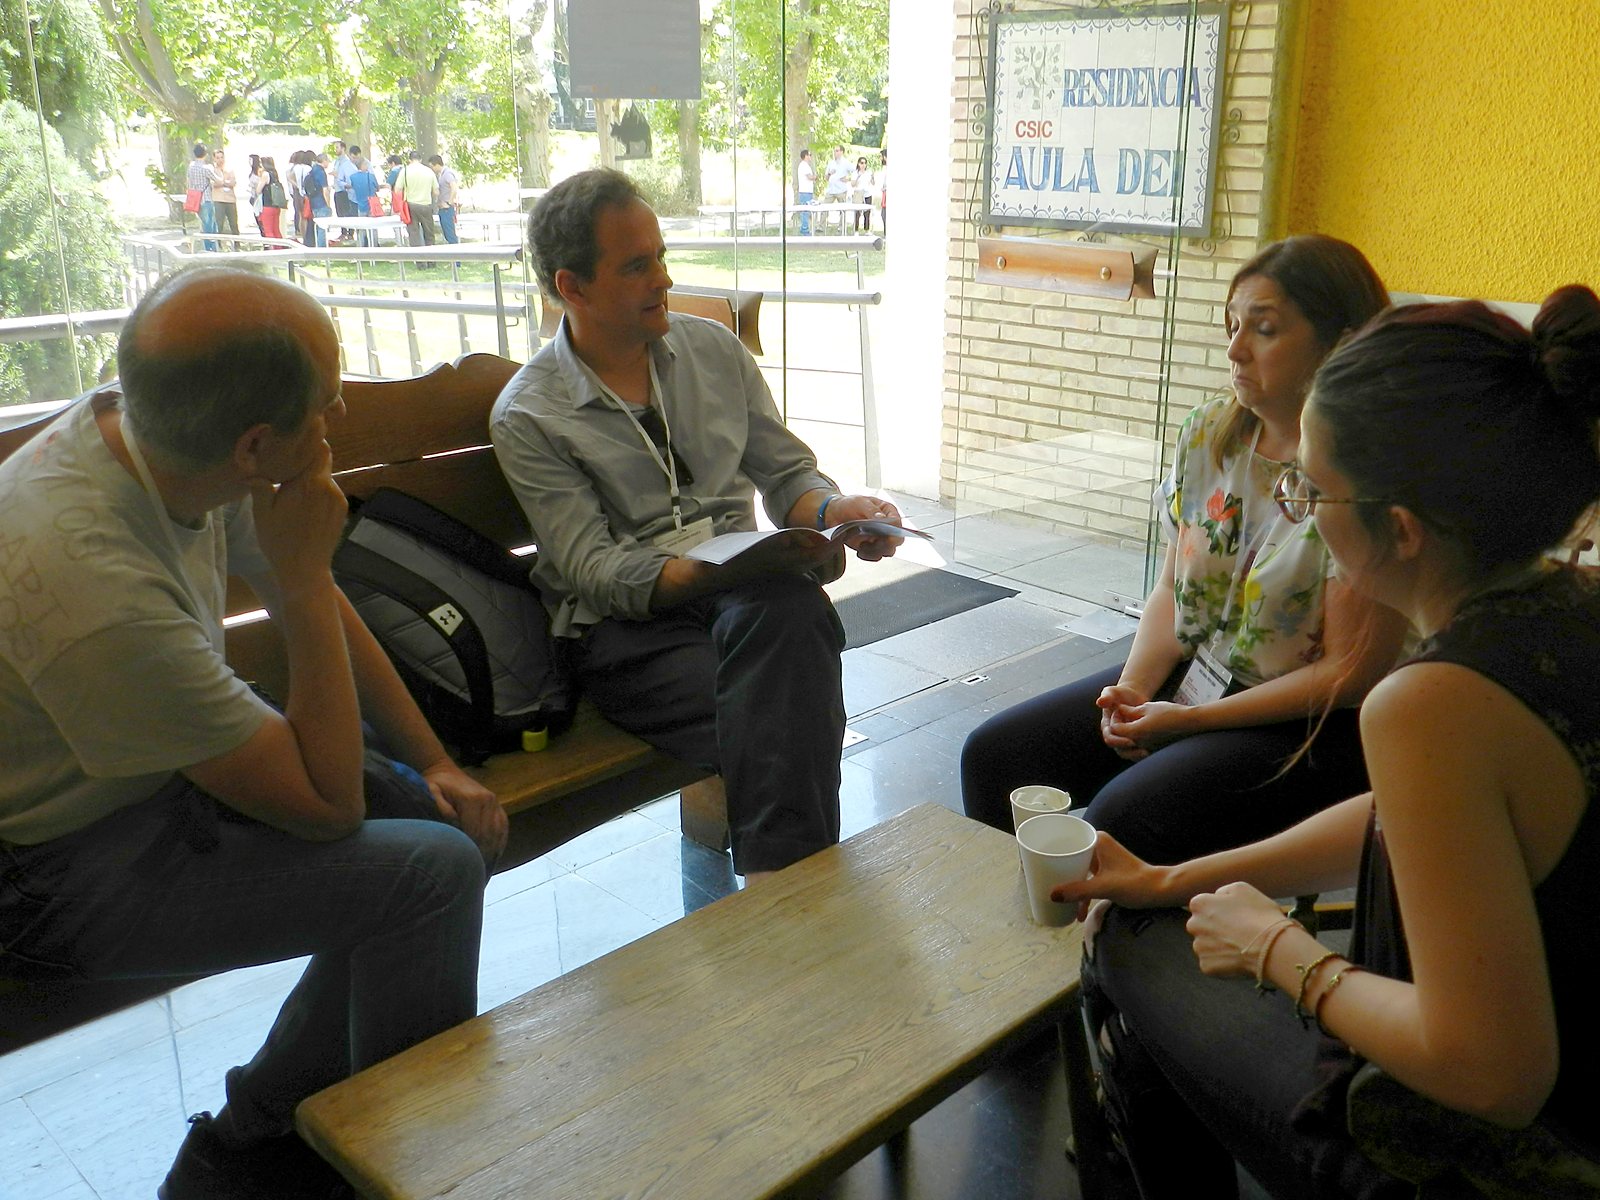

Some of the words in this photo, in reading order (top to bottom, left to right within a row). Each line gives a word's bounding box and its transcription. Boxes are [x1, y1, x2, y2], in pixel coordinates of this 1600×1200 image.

[1062, 67, 1202, 108] RESIDENCIA
[1015, 120, 1053, 138] CSIC
[1003, 146, 1101, 194] AULA
